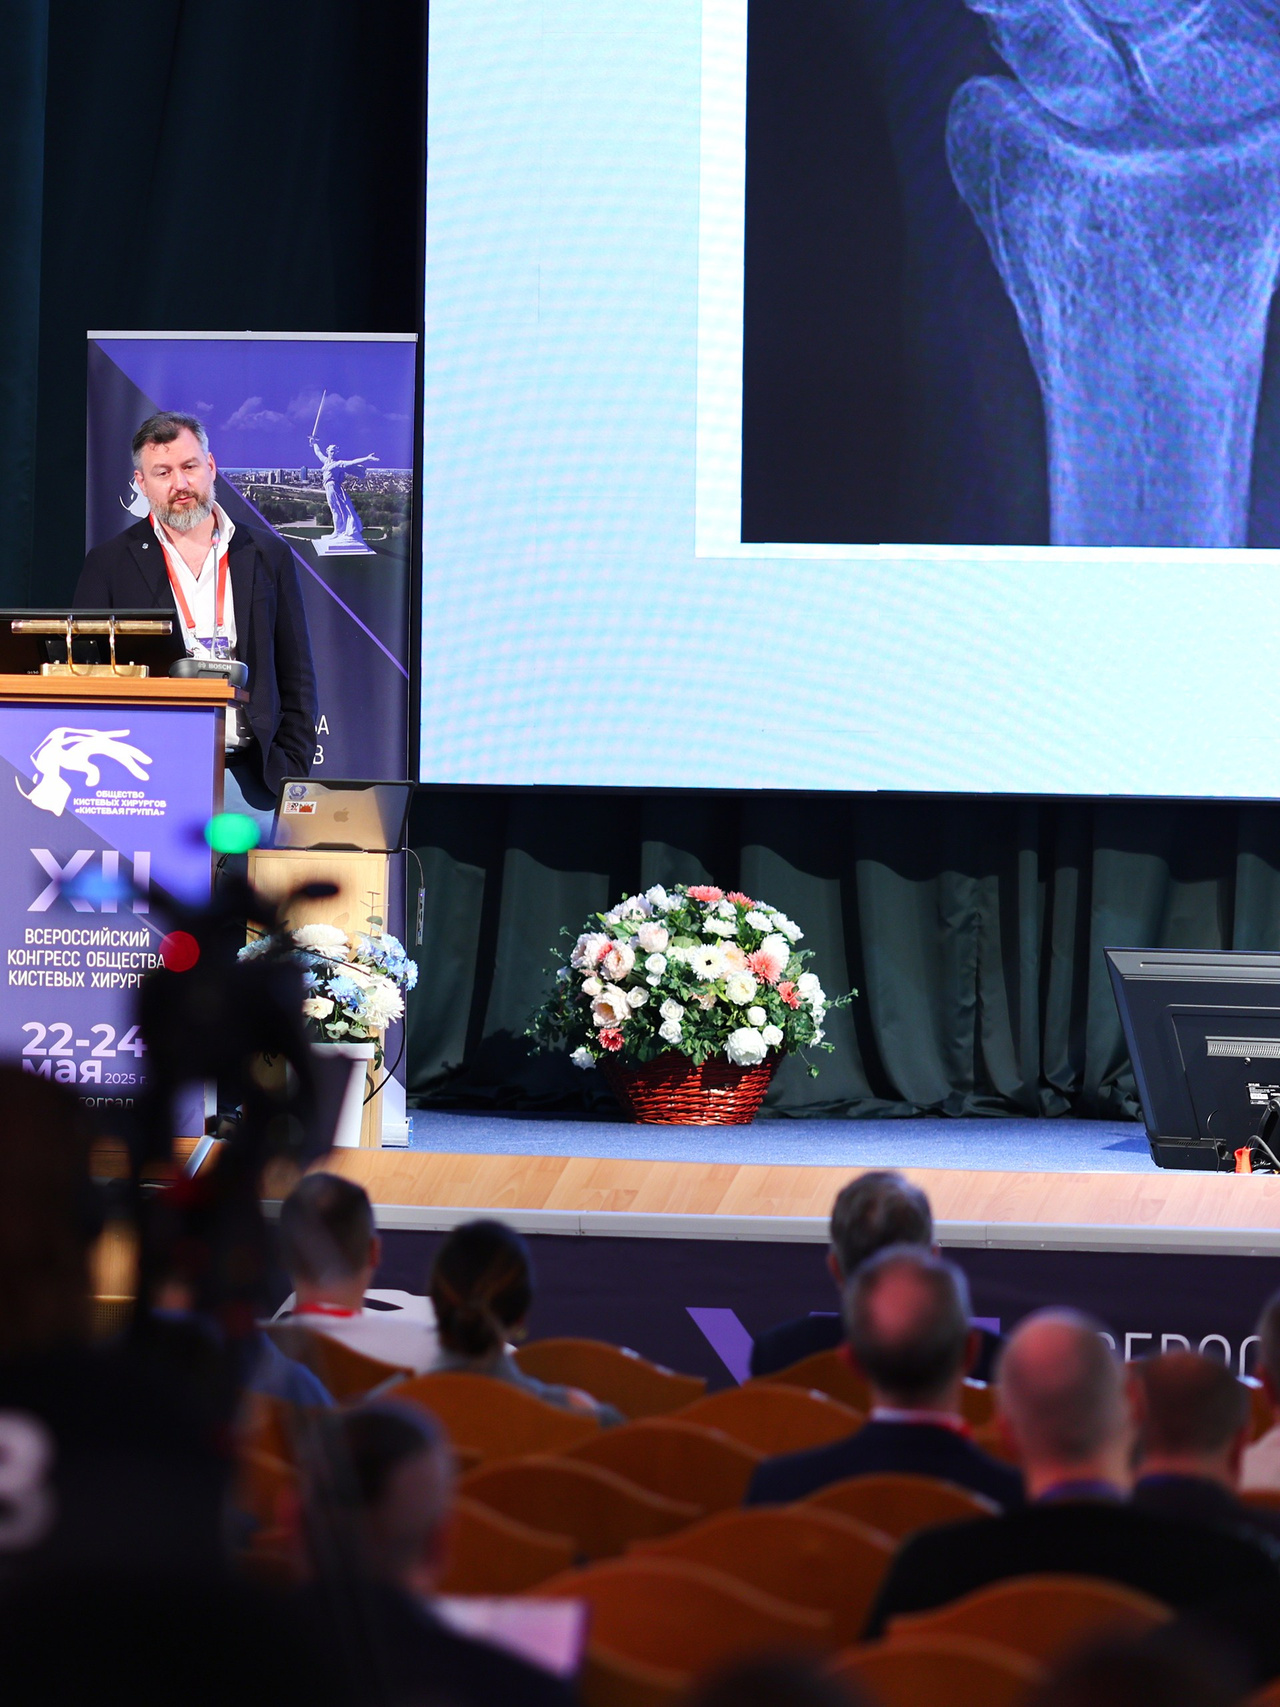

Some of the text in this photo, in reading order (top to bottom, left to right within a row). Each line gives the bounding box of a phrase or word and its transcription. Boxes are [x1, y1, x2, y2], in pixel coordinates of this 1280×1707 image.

[73, 798, 167, 808] КИСТЕВЫХ ХИРУРГОВ
[96, 790, 145, 799] ОБЩЕСТВО
[75, 806, 166, 816] «КИСТЕВАЯ ГРУППА»
[27, 848, 151, 914] XII
[25, 927, 150, 947] ВСЕРОССИЙСКИЙ
[7, 949, 166, 970] КОНГРЕСС ОБЩЕСТВА
[8, 970, 146, 989] КИСТЕВЫХ ХИРУРГ
[21, 1022, 148, 1058] 22-24
[22, 1058, 102, 1084] мая
[105, 1073, 137, 1085] 2025
